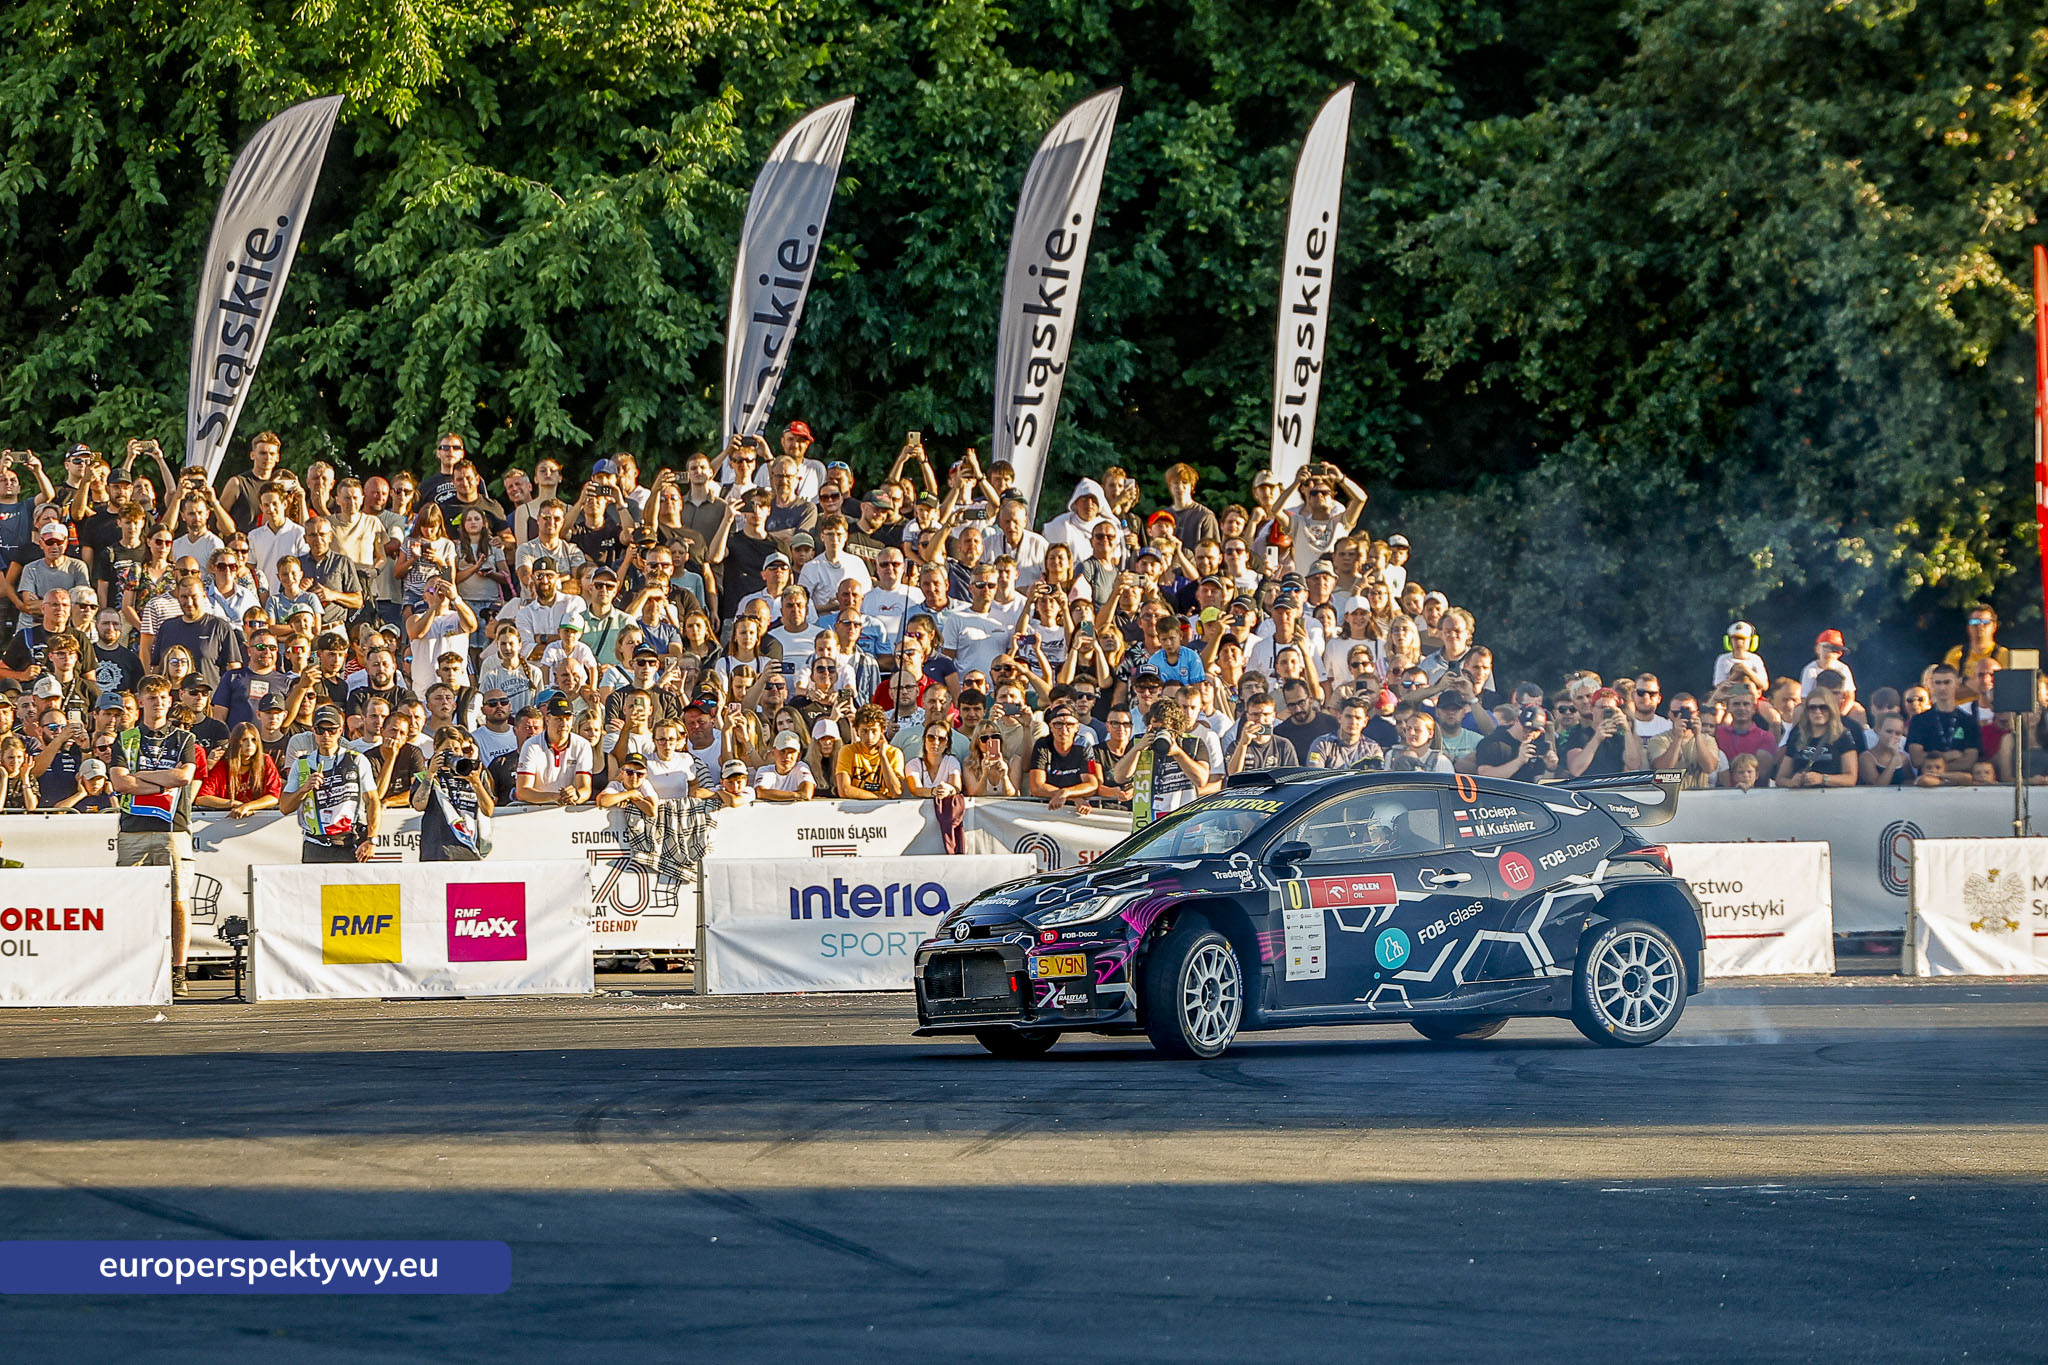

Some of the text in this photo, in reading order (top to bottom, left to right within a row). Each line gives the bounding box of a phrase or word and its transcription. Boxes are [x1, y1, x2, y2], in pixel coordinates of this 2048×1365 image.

[196, 214, 290, 448] Śląskie.
[1005, 212, 1083, 449] Śląskie.
[1277, 210, 1330, 448] Śląskie.
[490, 747, 510, 757] RALLY
[1135, 769, 1151, 804] 251
[1455, 773, 1479, 803] 0
[1207, 799, 1285, 813] CONTROL
[1468, 805, 1518, 820] T.Ociepa
[571, 831, 619, 844] STADION
[797, 824, 887, 843] STADION ŚLĄSKI
[1474, 820, 1537, 837] M.Kuśnierz
[393, 831, 421, 851] ŚLĄS
[1538, 836, 1601, 871] FOB-Decor
[1212, 867, 1252, 880] Tradepol
[1287, 880, 1303, 910] 0
[1351, 882, 1380, 891] ORLEN
[1353, 891, 1365, 899] OIL
[1691, 878, 1743, 894] rstwo
[789, 877, 951, 920] interia
[454, 908, 482, 918] RMF
[592, 905, 607, 917] AT
[1701, 898, 1785, 920] Turystyki
[0, 907, 104, 931] ORLEN
[331, 914, 393, 937] RMF
[592, 920, 639, 932] EGENDY
[1417, 900, 1484, 945] FOB-Glass
[820, 930, 928, 958] SPORT
[1061, 930, 1099, 940] FOB-Decor
[0, 939, 39, 957] OIL
[1038, 956, 1086, 975] S V9N
